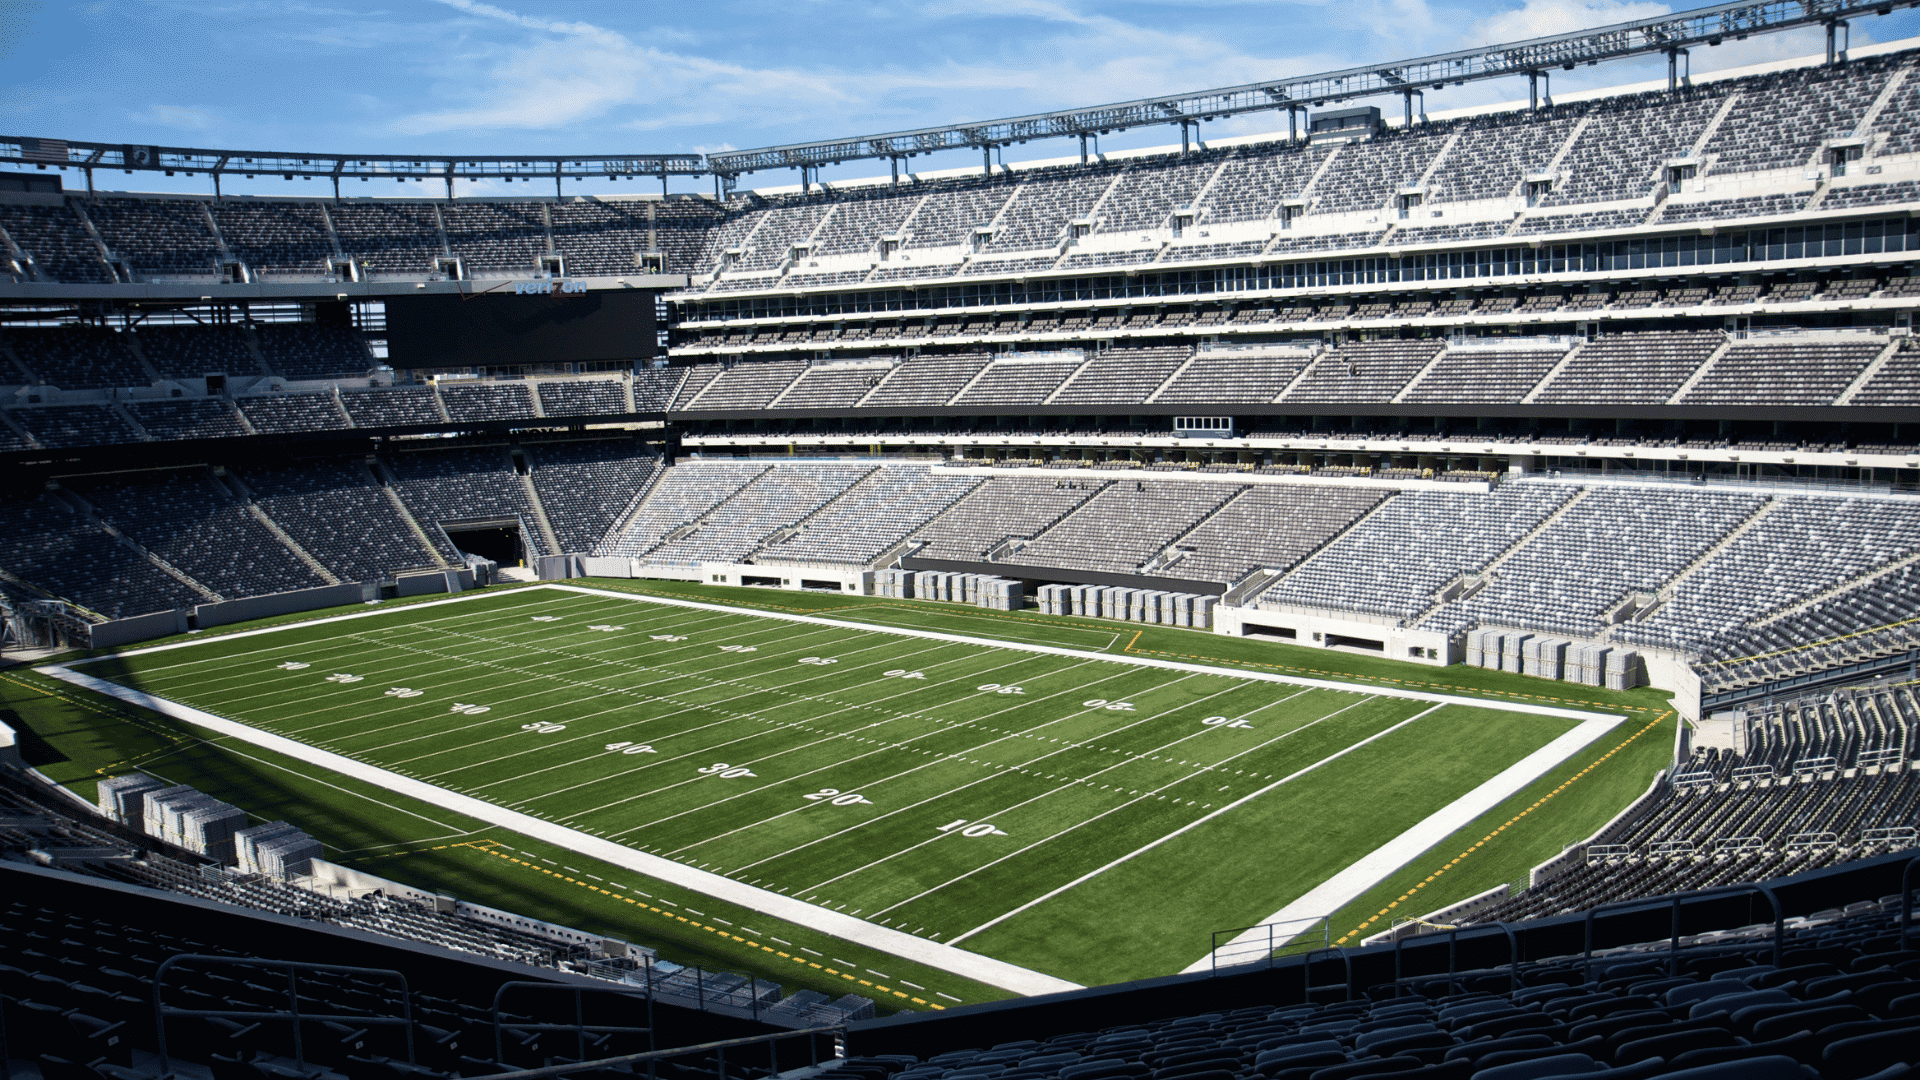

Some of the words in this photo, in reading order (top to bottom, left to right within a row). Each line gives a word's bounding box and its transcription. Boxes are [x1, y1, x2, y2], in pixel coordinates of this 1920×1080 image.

[514, 275, 587, 295] verizon
[385, 687, 424, 698] 30
[977, 684, 1023, 694] 30
[450, 703, 490, 715] 40
[1083, 699, 1134, 710] 20
[521, 721, 566, 733] 50
[1202, 716, 1250, 728] 10
[605, 741, 652, 754] 40
[698, 763, 750, 778] 30
[803, 788, 864, 806] 20
[936, 819, 996, 837] 10
